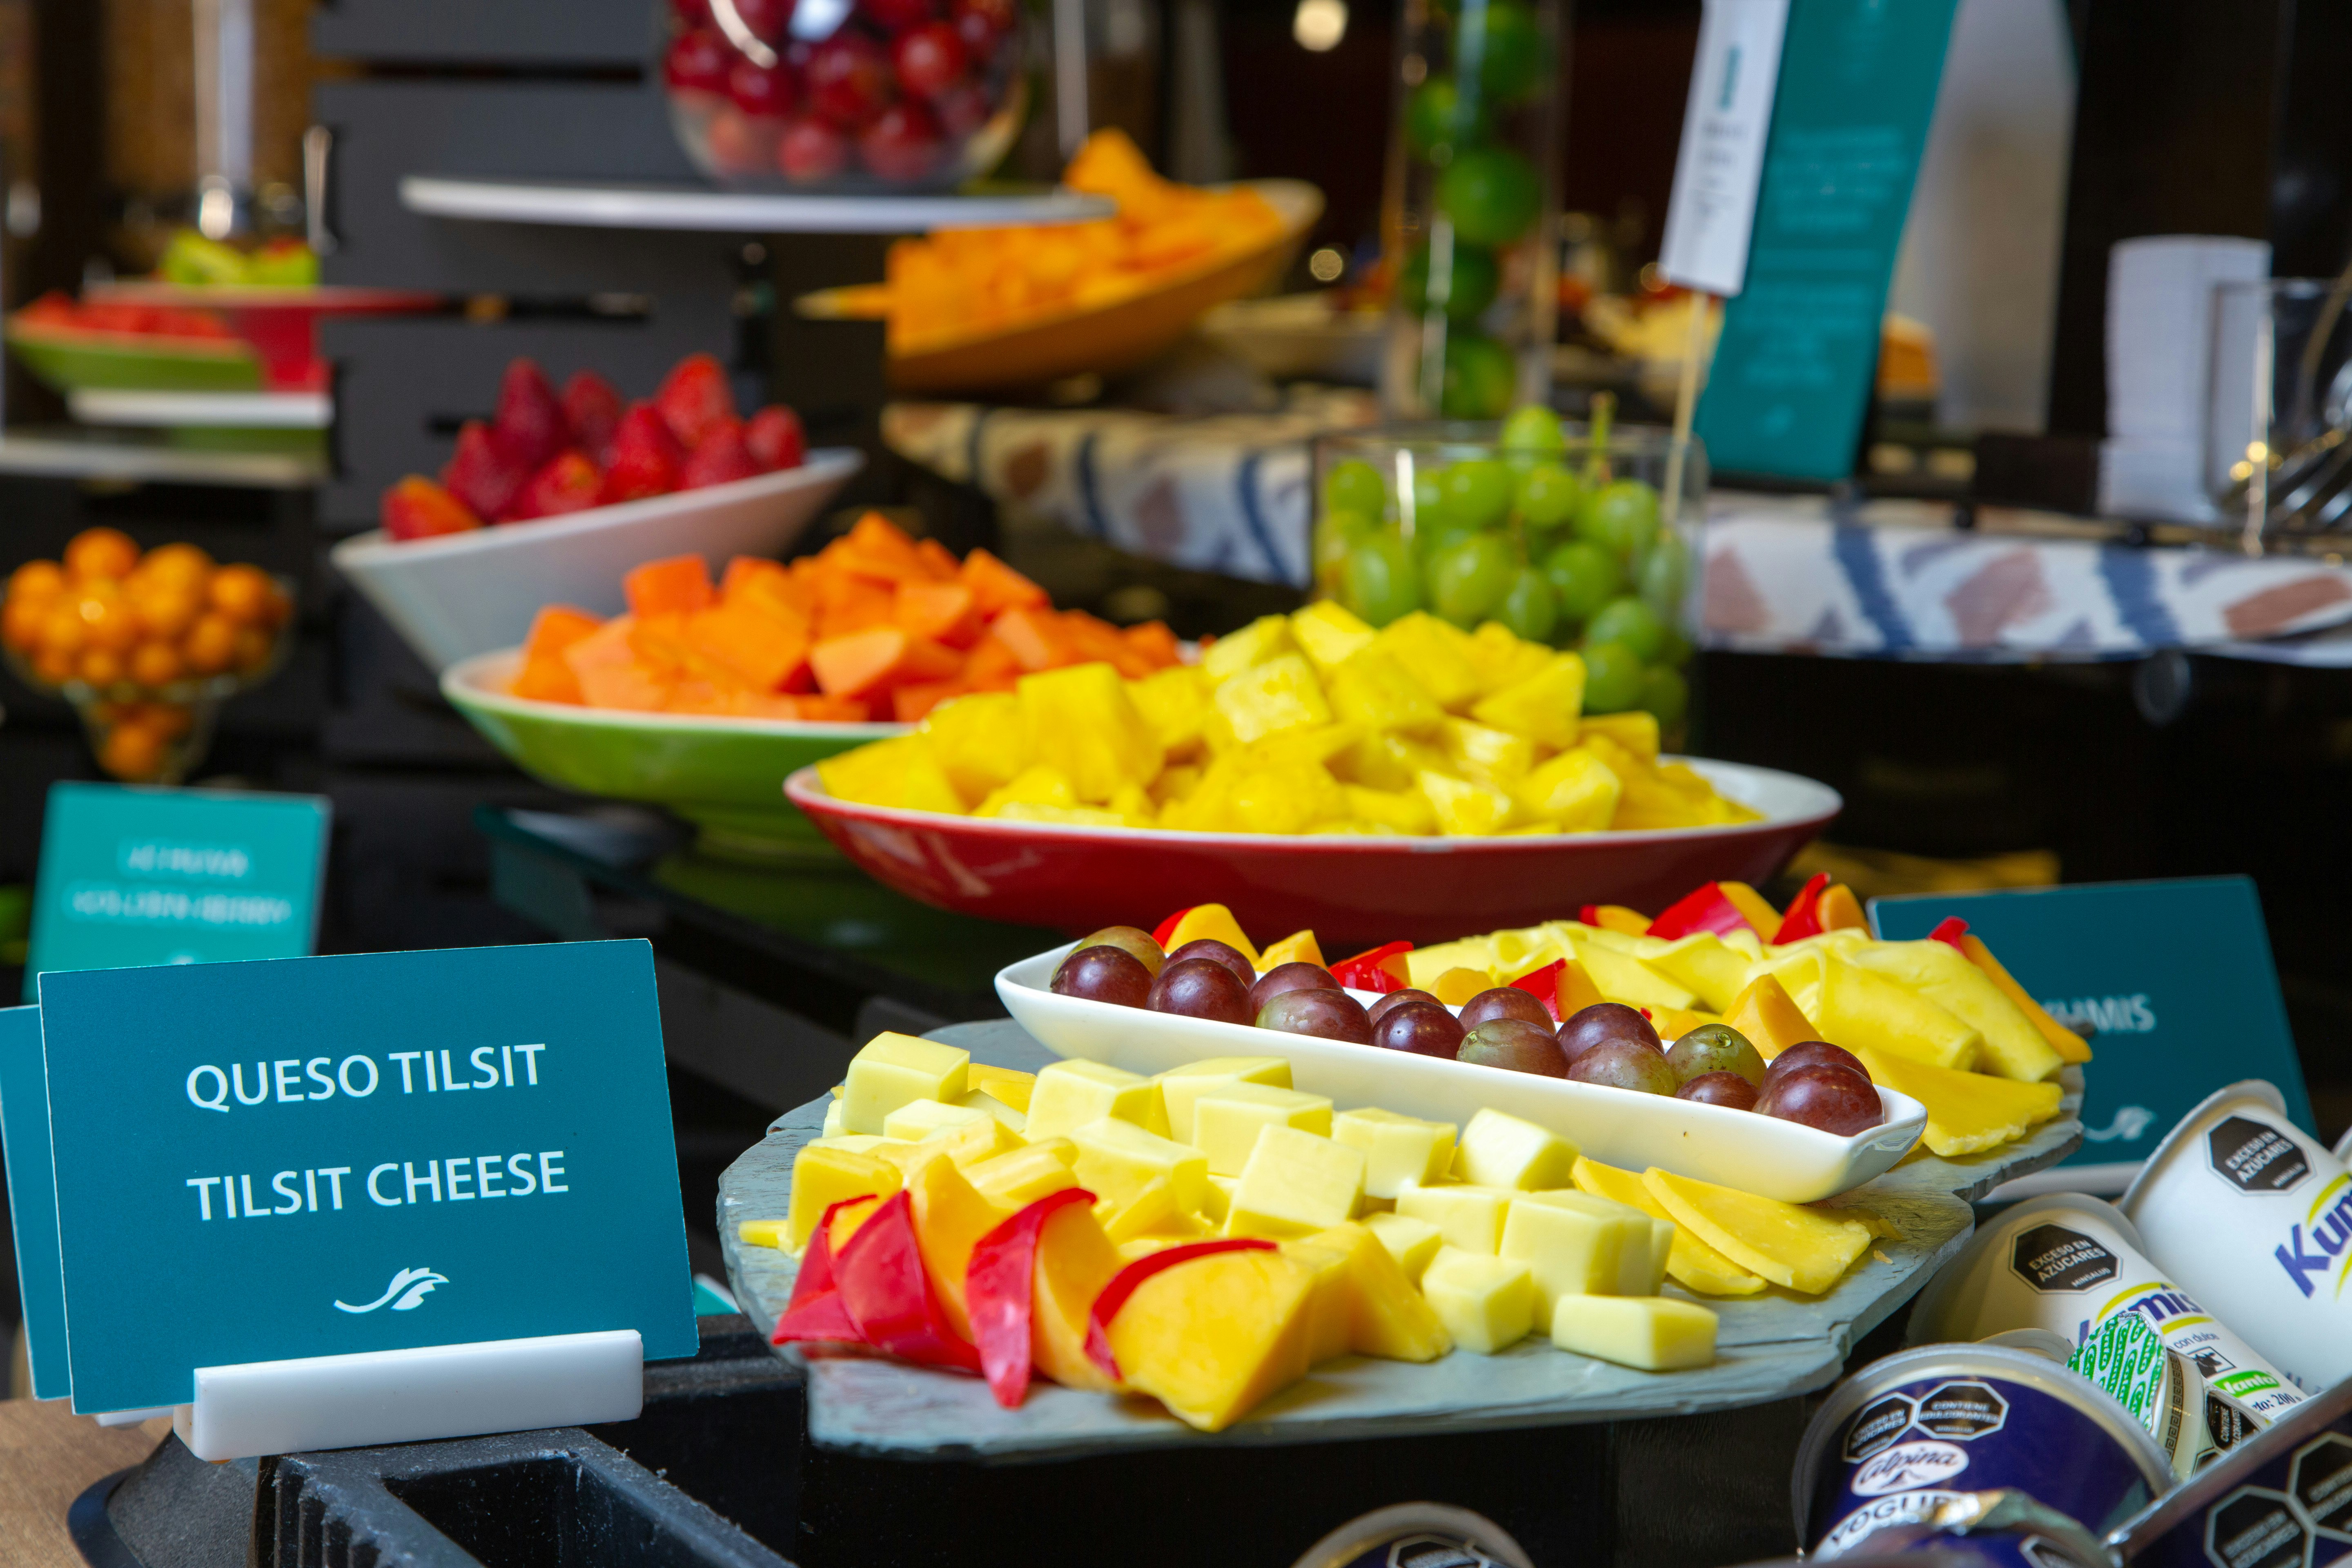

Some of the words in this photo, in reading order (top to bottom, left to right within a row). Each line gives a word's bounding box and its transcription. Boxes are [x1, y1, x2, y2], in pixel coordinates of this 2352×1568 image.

[187, 1055, 378, 1111] QUESO
[390, 1044, 545, 1092] TILSIT
[2225, 1137, 2266, 1170] EXCESO
[187, 1167, 350, 1219] TILSIT
[368, 1151, 568, 1205] CHEESE
[2028, 1244, 2075, 1270] EXCESO
[2071, 1239, 2092, 1250] EN
[2071, 1267, 2112, 1287] MINSALUD
[2173, 1338, 2195, 1349] con
[2223, 1374, 2277, 1394] lanta
[2270, 1393, 2296, 1405] 200
